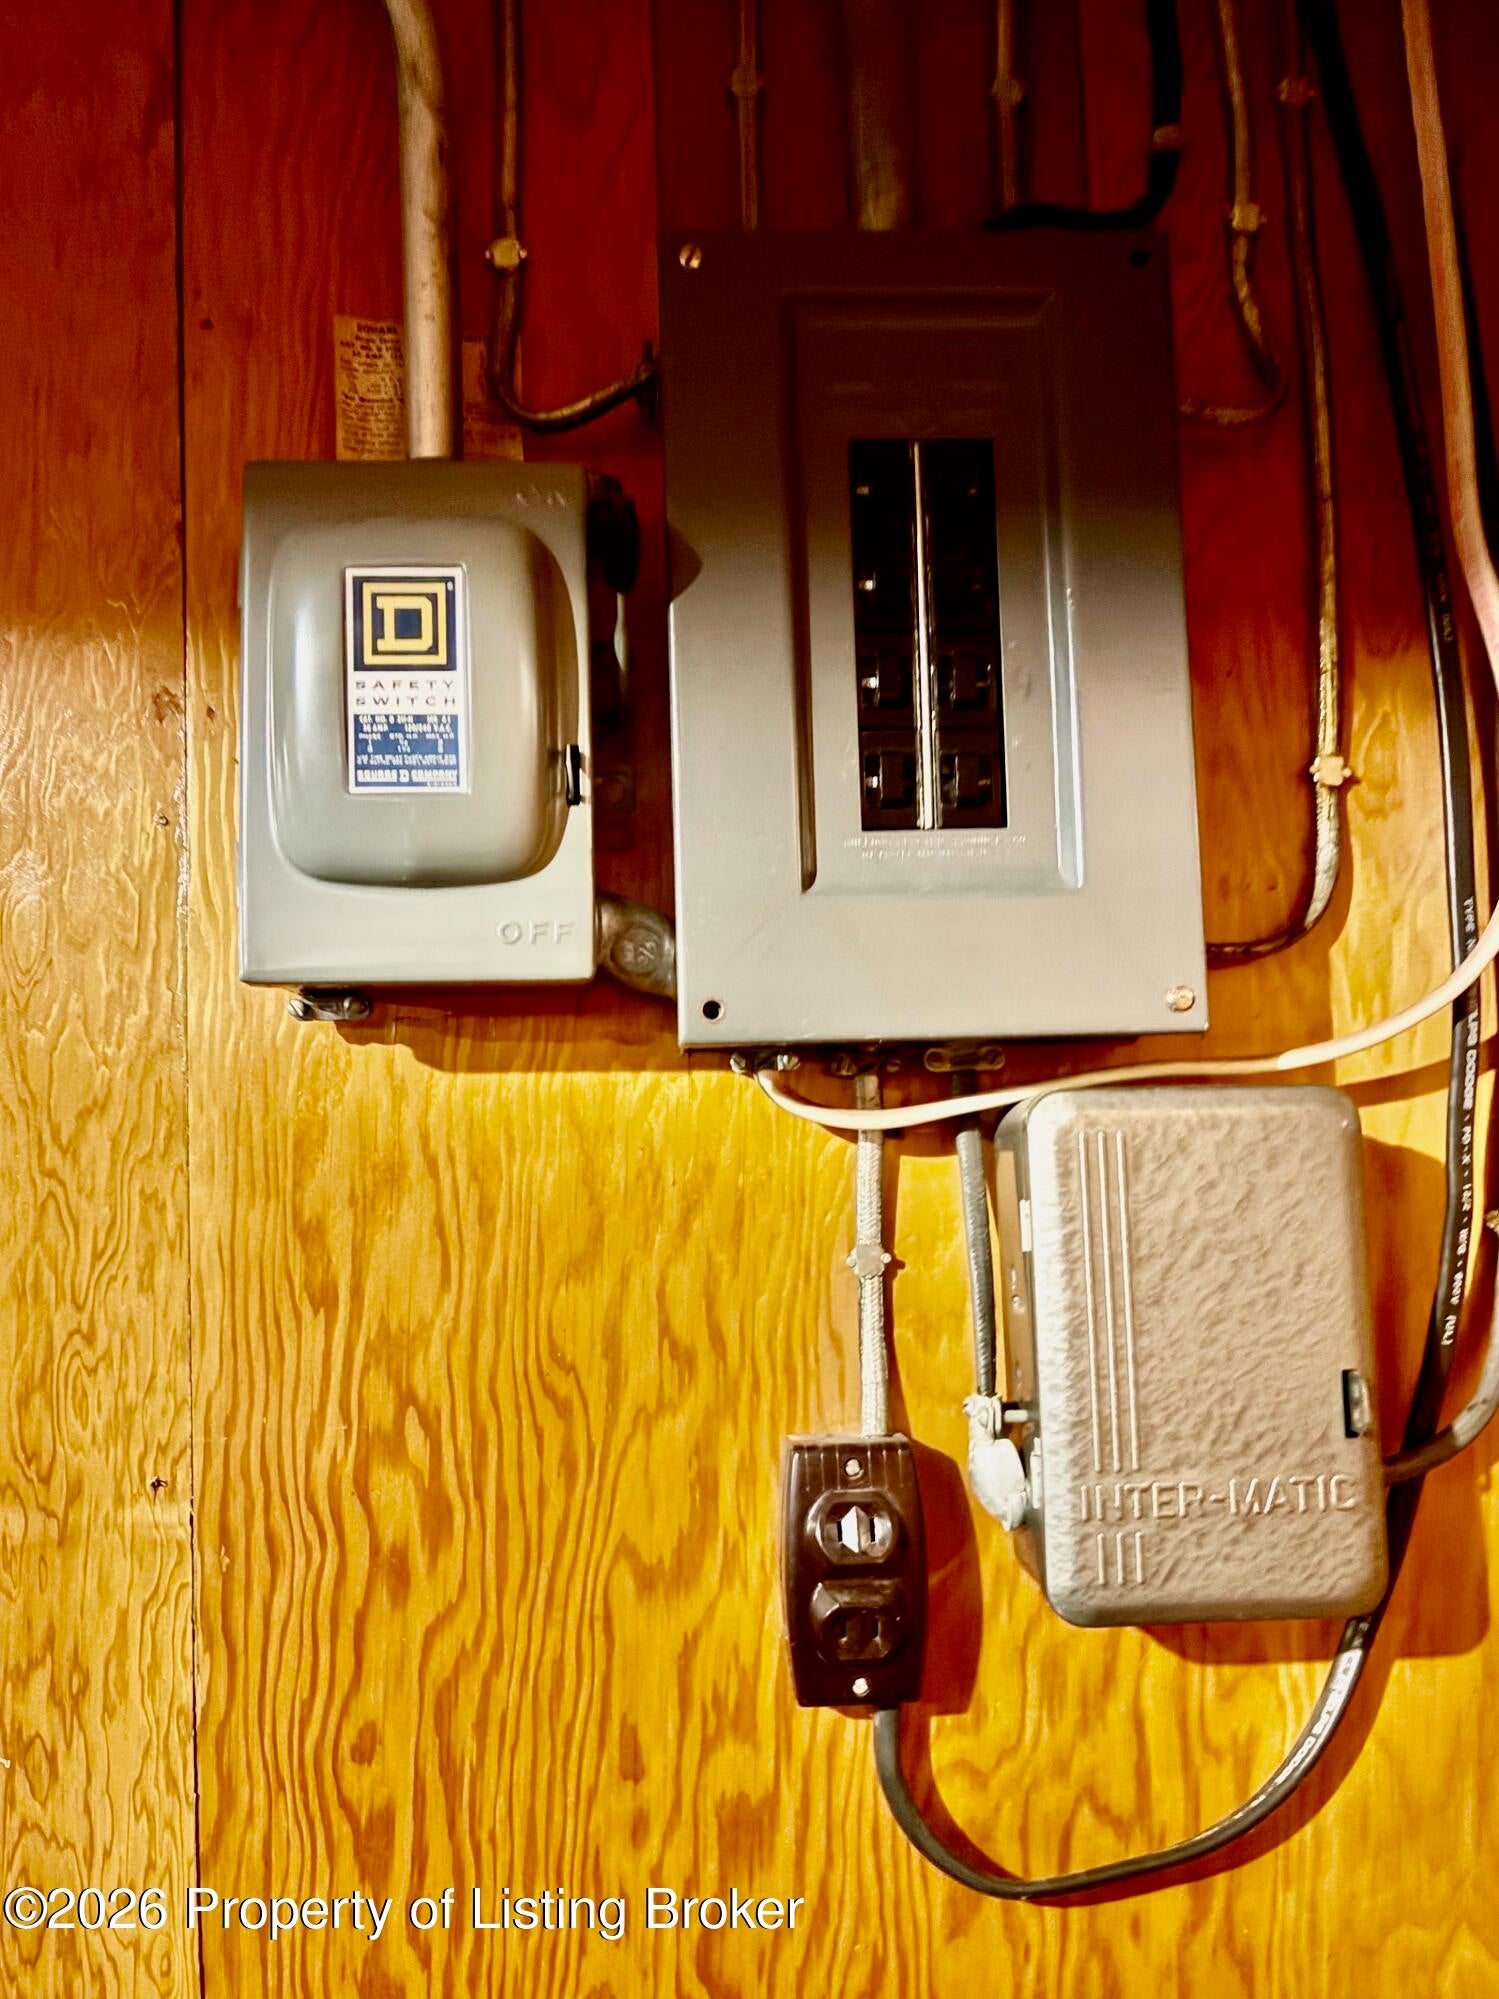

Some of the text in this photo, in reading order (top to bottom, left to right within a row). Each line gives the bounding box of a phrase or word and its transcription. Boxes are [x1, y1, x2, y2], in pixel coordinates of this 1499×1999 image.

[355, 679, 454, 690] SAFETY
[355, 695, 456, 706] SWITCH
[1463, 895, 1476, 933] TYPE
[496, 919, 575, 946] OFF
[1080, 1473, 1358, 1522] INTER-MATIC
